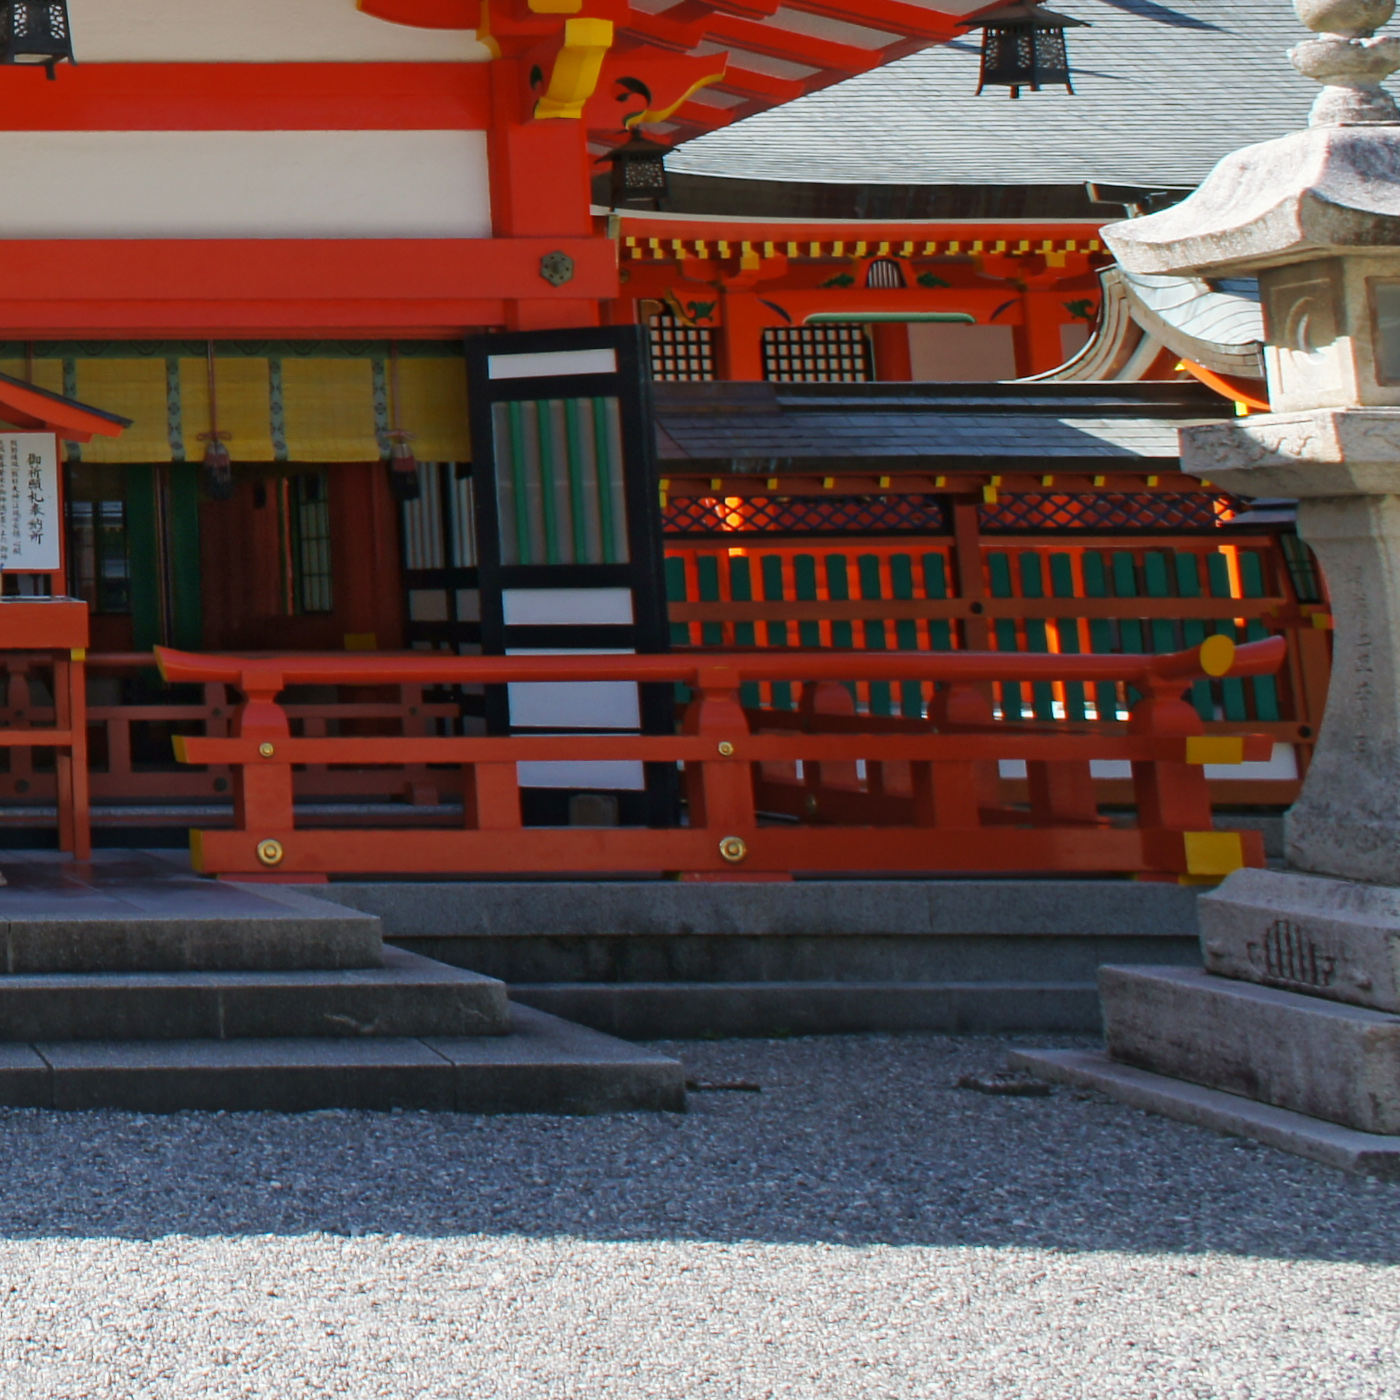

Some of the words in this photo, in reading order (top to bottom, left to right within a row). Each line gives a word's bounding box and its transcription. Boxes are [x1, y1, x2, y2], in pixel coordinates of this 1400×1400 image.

[27, 453, 45, 545] 御祈願札奉納所
